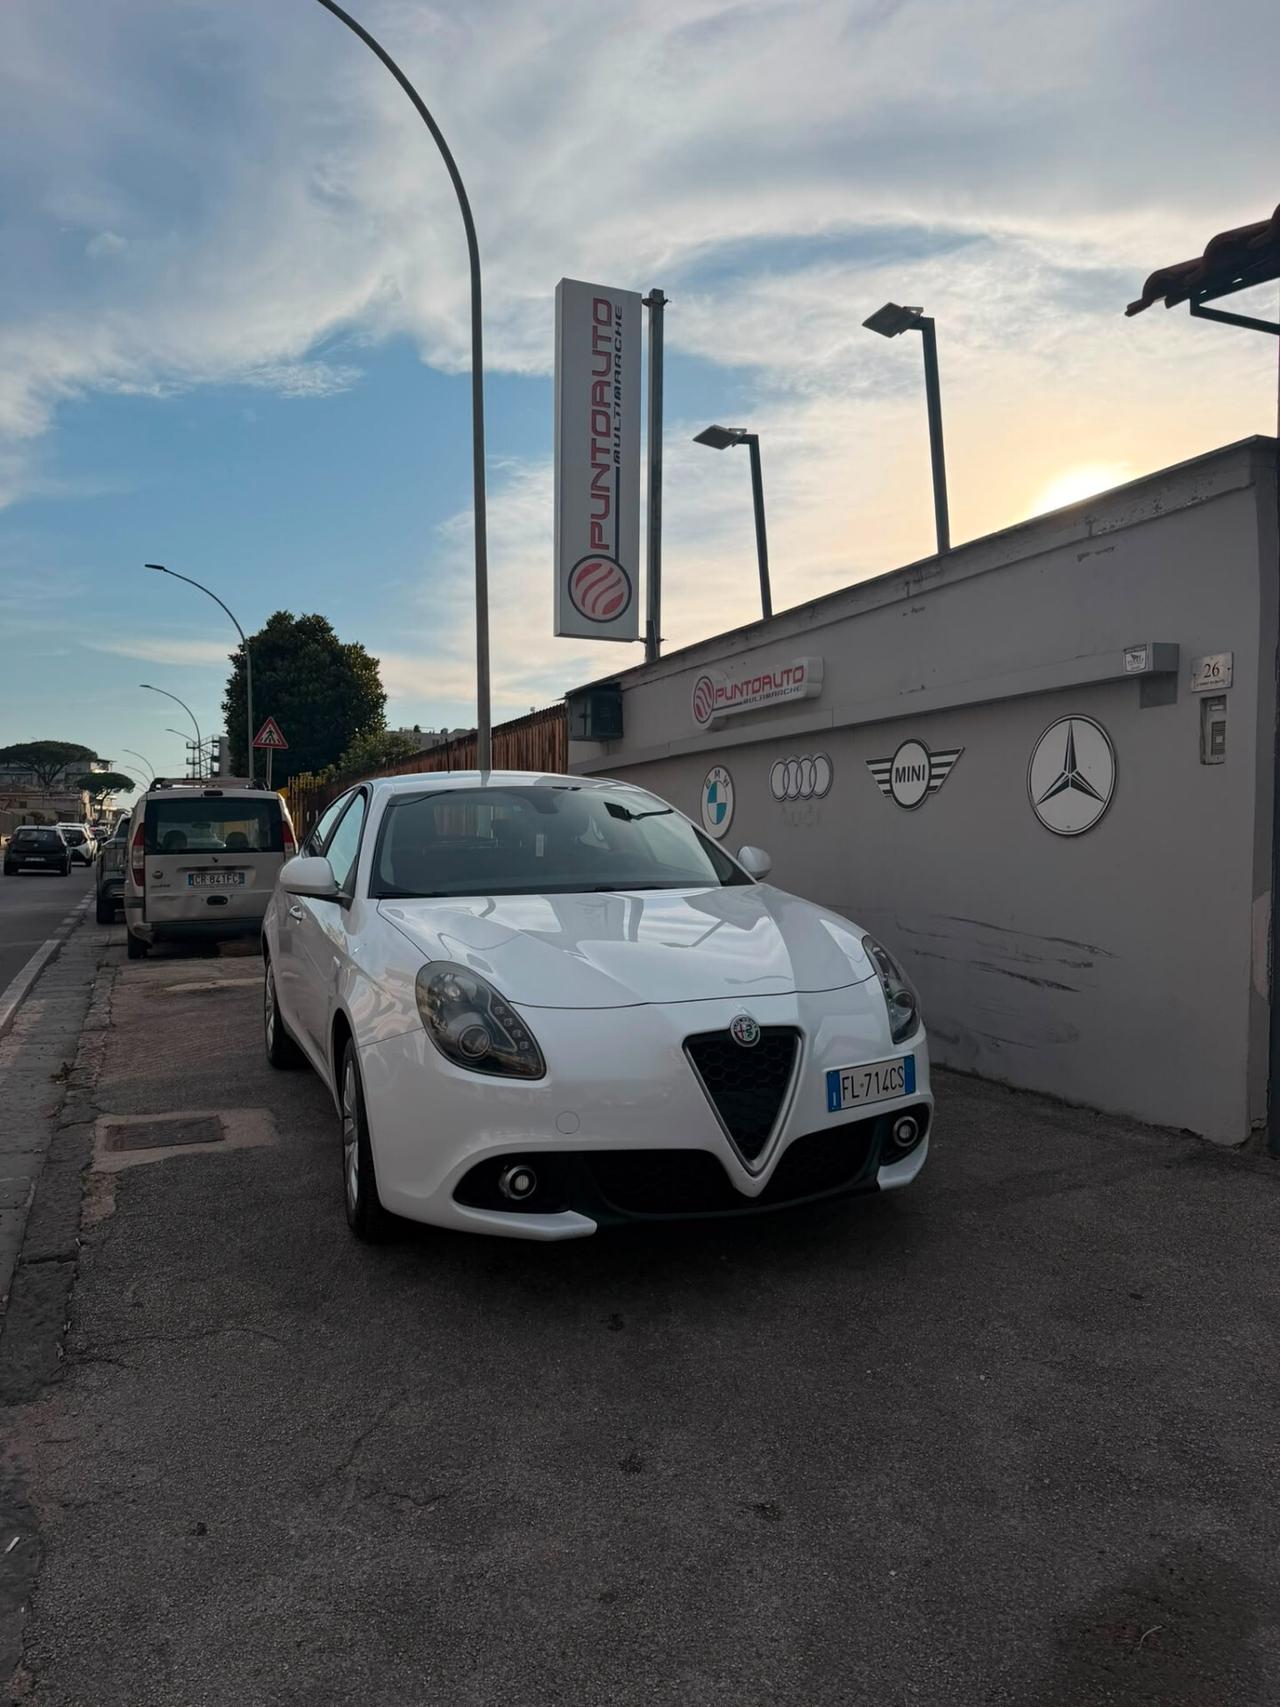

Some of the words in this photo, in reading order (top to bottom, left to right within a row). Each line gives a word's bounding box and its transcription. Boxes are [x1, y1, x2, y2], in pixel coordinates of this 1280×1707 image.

[613, 303, 624, 466] MULTIMARCHE
[590, 298, 612, 551] PUNTOAUTO
[715, 665, 805, 704] PUNTOAUTO
[1203, 662, 1220, 678] 26
[705, 768, 730, 790] BMW
[895, 764, 926, 783] MINI
